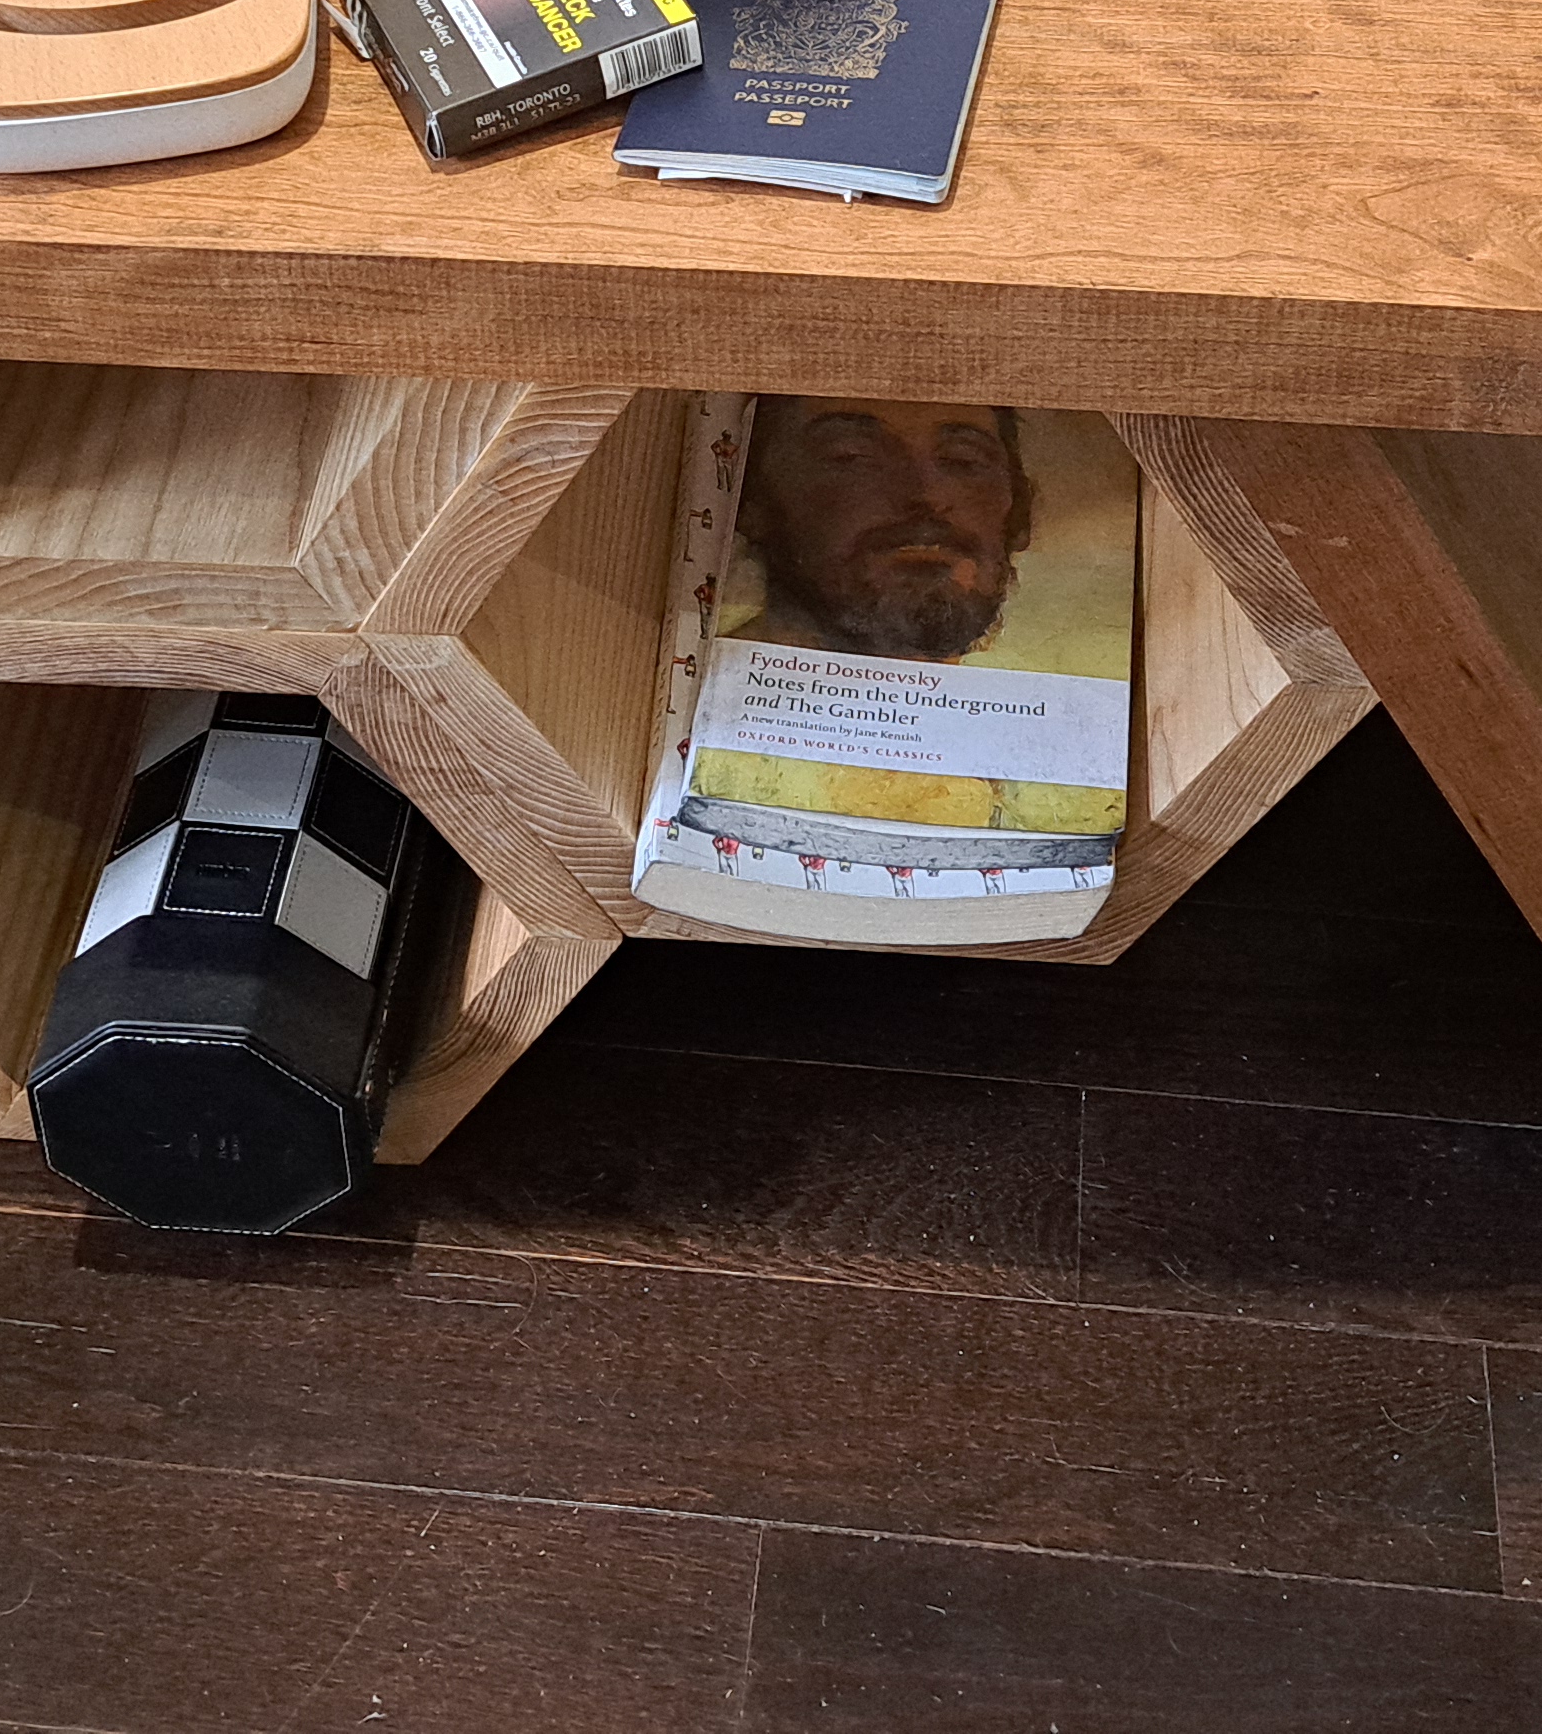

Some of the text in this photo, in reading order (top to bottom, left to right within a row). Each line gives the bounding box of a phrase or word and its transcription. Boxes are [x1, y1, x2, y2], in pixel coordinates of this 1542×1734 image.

[426, 14, 455, 48] Select
[419, 47, 438, 63] 20
[507, 83, 571, 115] TORONTO
[734, 92, 853, 109] PASSEPORT
[744, 78, 851, 95] PASSPORT
[750, 651, 942, 691] Fyodor Dostoevsky
[744, 694, 920, 727] and The Gambler
[747, 672, 1046, 717] Notes from the Underground
[740, 712, 923, 743] A new translation by Jane Kentish
[737, 730, 944, 762] OXFORD WORLD'S CLASSICS
